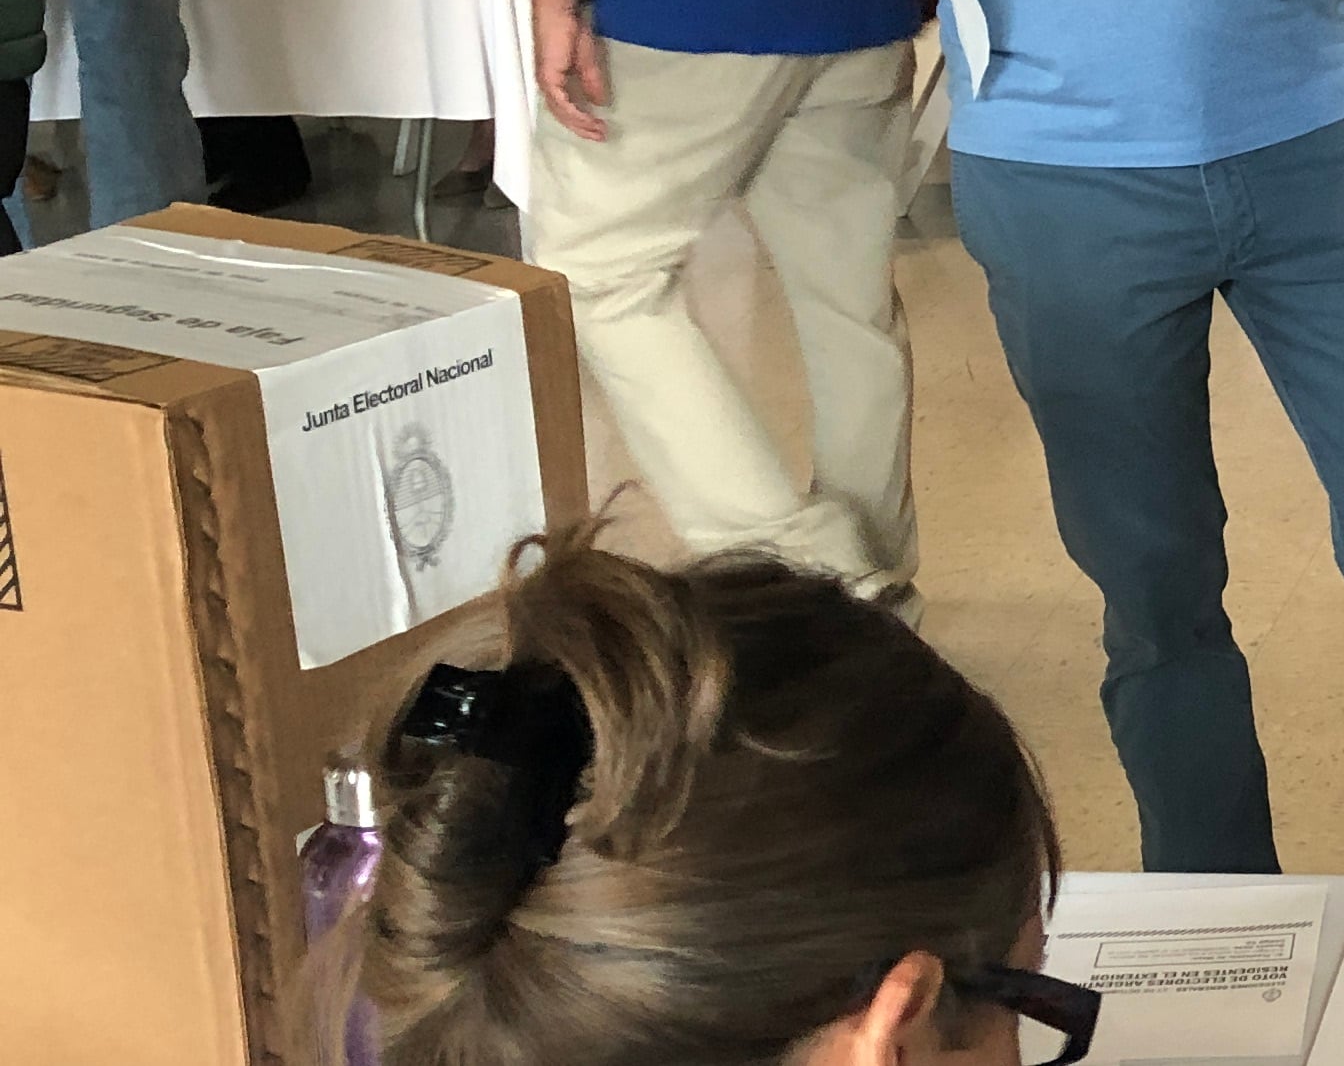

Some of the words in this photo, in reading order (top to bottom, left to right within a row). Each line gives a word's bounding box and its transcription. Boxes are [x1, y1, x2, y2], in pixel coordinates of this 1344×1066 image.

[176, 317, 222, 328] de
[226, 326, 304, 346] Faja
[302, 403, 350, 432] Junta
[352, 373, 423, 414] Electoral
[426, 348, 493, 387] Nacional
[1182, 970, 1200, 978] EN
[1203, 966, 1288, 976] RESIDENTES
[1090, 972, 1158, 982] EXTERIOR
[1148, 976, 1226, 986] ELECTORES
[1252, 973, 1288, 982] VOTO
